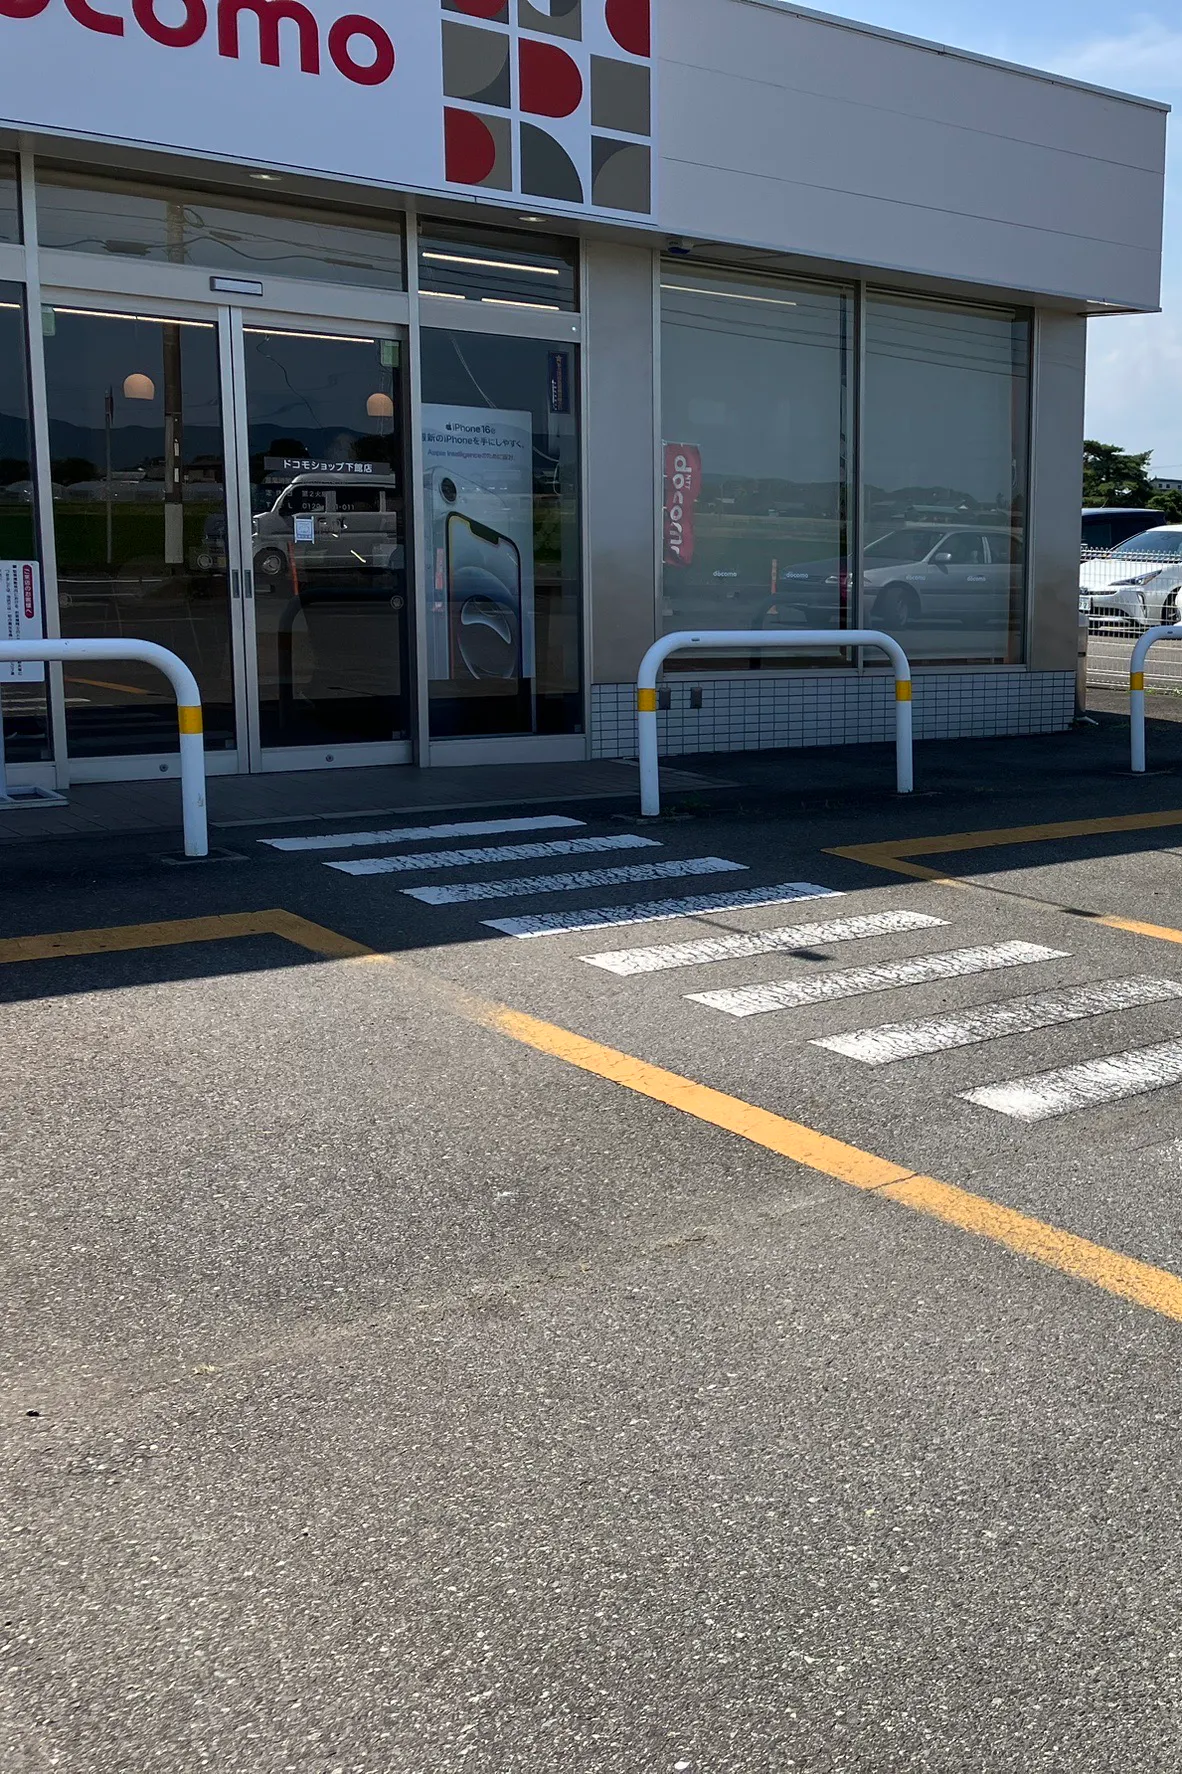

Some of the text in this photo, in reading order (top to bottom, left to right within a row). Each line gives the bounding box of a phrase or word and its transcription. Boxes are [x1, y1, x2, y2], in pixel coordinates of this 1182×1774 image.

[452, 423, 496, 435] iPhone 16e
[283, 459, 373, 473] ドコモショップ下館店
